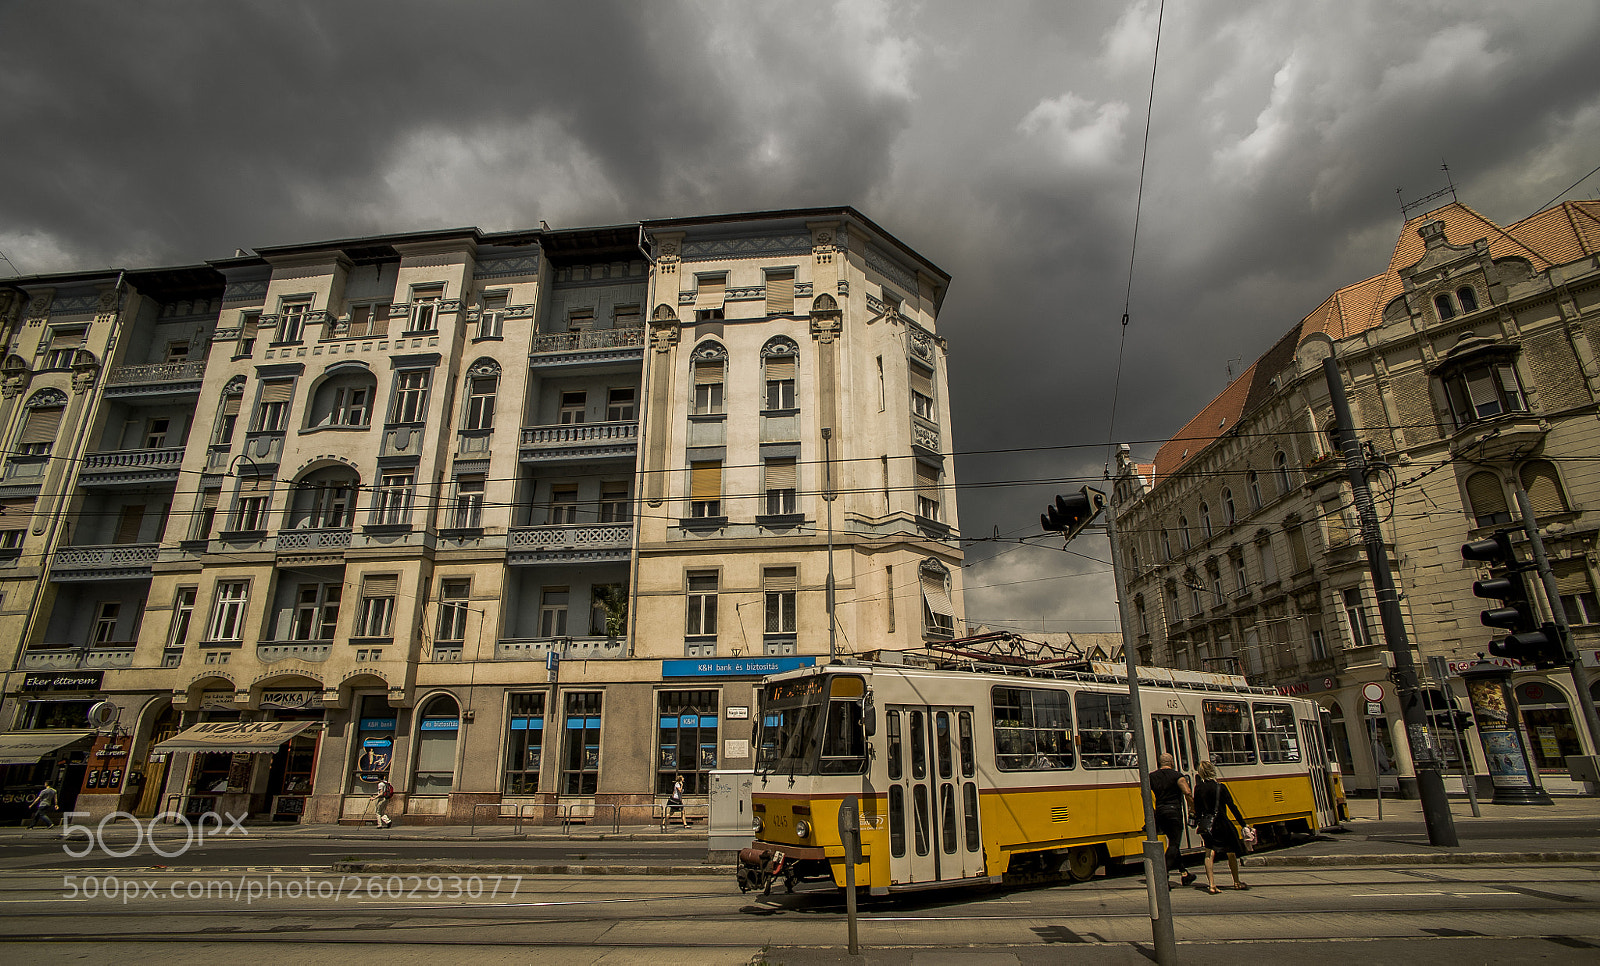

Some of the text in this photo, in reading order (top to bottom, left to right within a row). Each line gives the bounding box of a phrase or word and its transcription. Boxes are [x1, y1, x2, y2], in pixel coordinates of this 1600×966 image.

[716, 663, 732, 671] bank
[735, 662, 743, 671] és
[746, 661, 779, 671] biztosítás
[27, 677, 97, 686] Eker étterem
[773, 815, 789, 828] 4245
